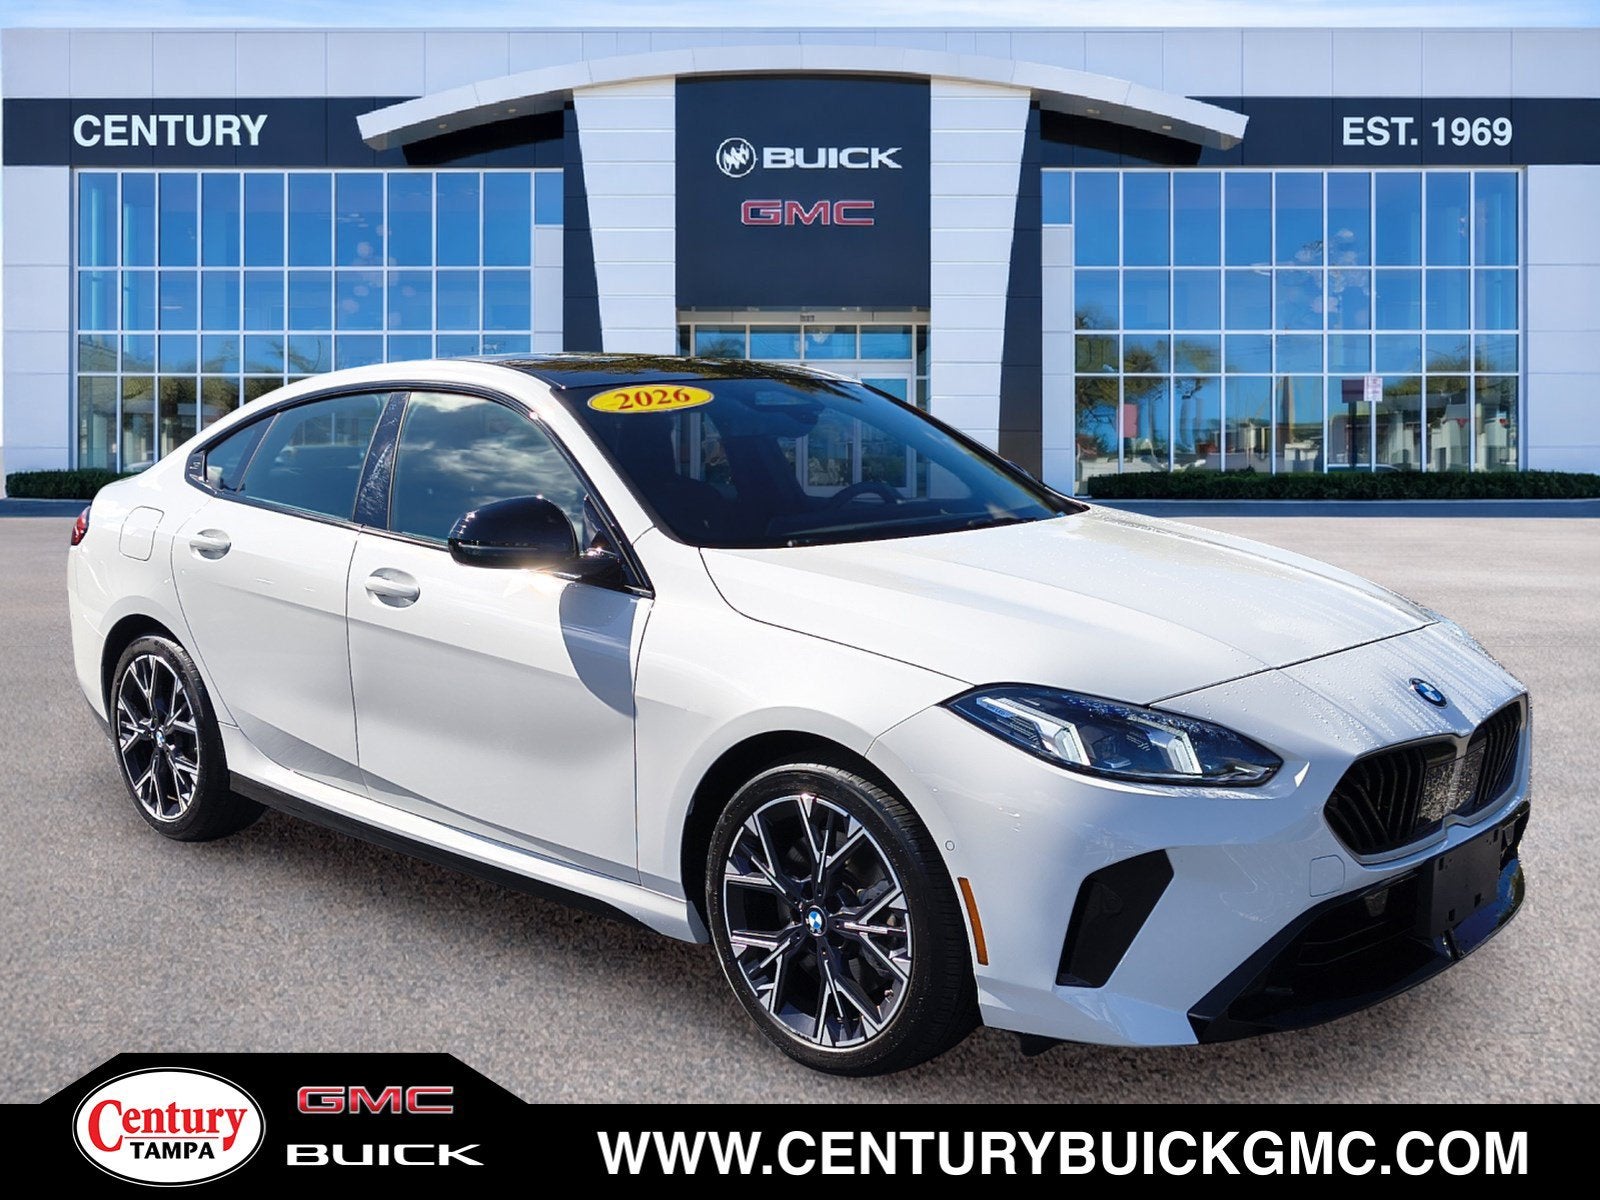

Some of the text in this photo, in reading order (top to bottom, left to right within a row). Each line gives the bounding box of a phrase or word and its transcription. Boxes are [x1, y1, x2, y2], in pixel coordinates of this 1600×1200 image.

[73, 114, 267, 147] CENTURY
[1343, 116, 1513, 146] EST. 1969
[763, 147, 903, 169] BUICK
[741, 199, 875, 226] GMC
[614, 388, 691, 410] 2026
